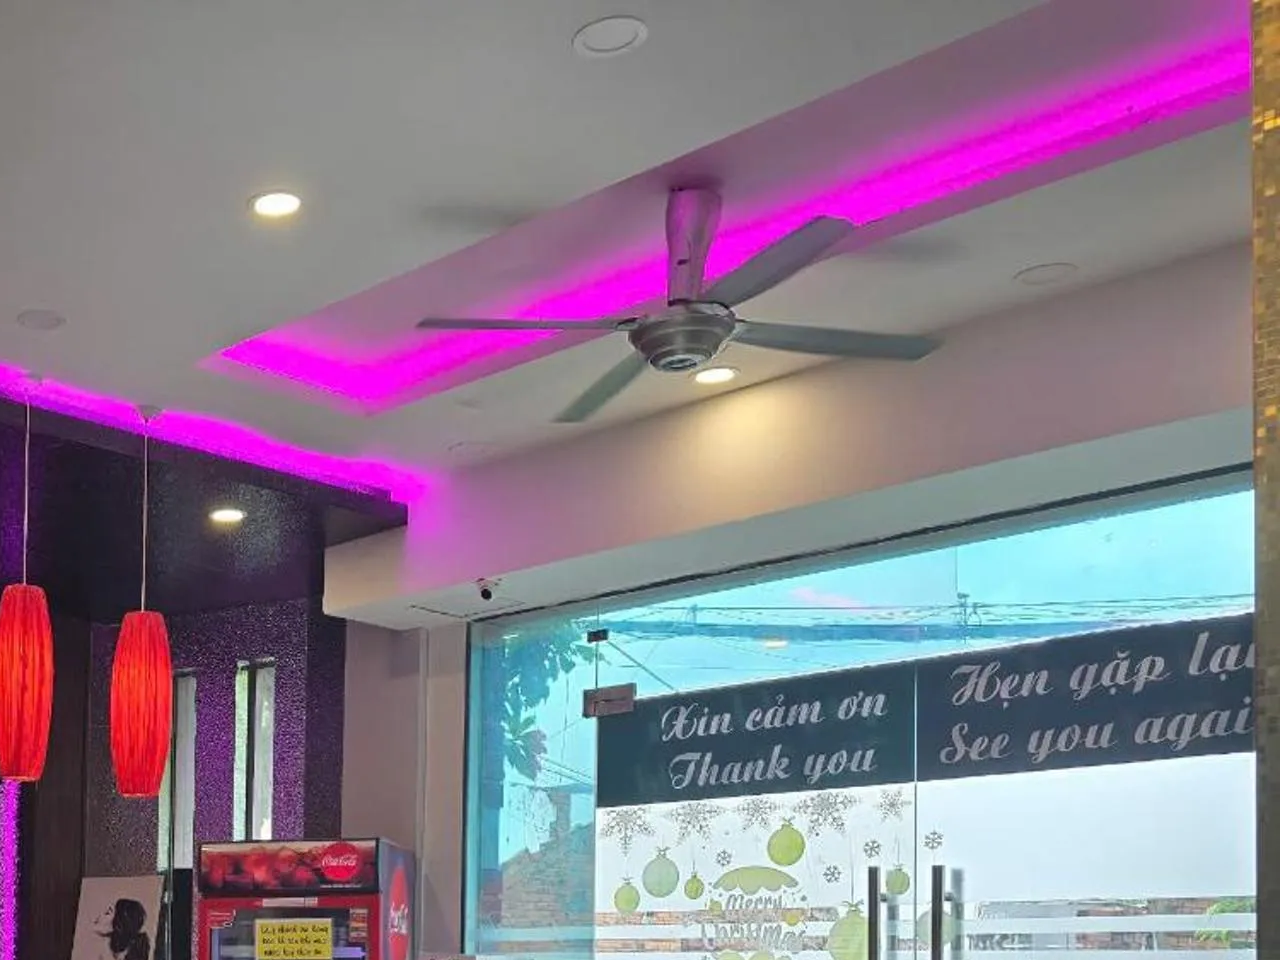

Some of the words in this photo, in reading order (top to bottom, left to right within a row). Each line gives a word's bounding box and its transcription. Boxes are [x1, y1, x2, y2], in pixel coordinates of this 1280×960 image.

[950, 661, 1054, 709] Hẹn
[1069, 650, 1170, 701] gặp
[661, 703, 734, 741] Xin
[745, 694, 826, 732] cảm
[837, 691, 888, 720] ơn
[940, 723, 1012, 764] See
[1028, 720, 1117, 764] you
[1134, 696, 1255, 751] agai
[670, 744, 791, 789] Thank
[803, 748, 878, 785] you
